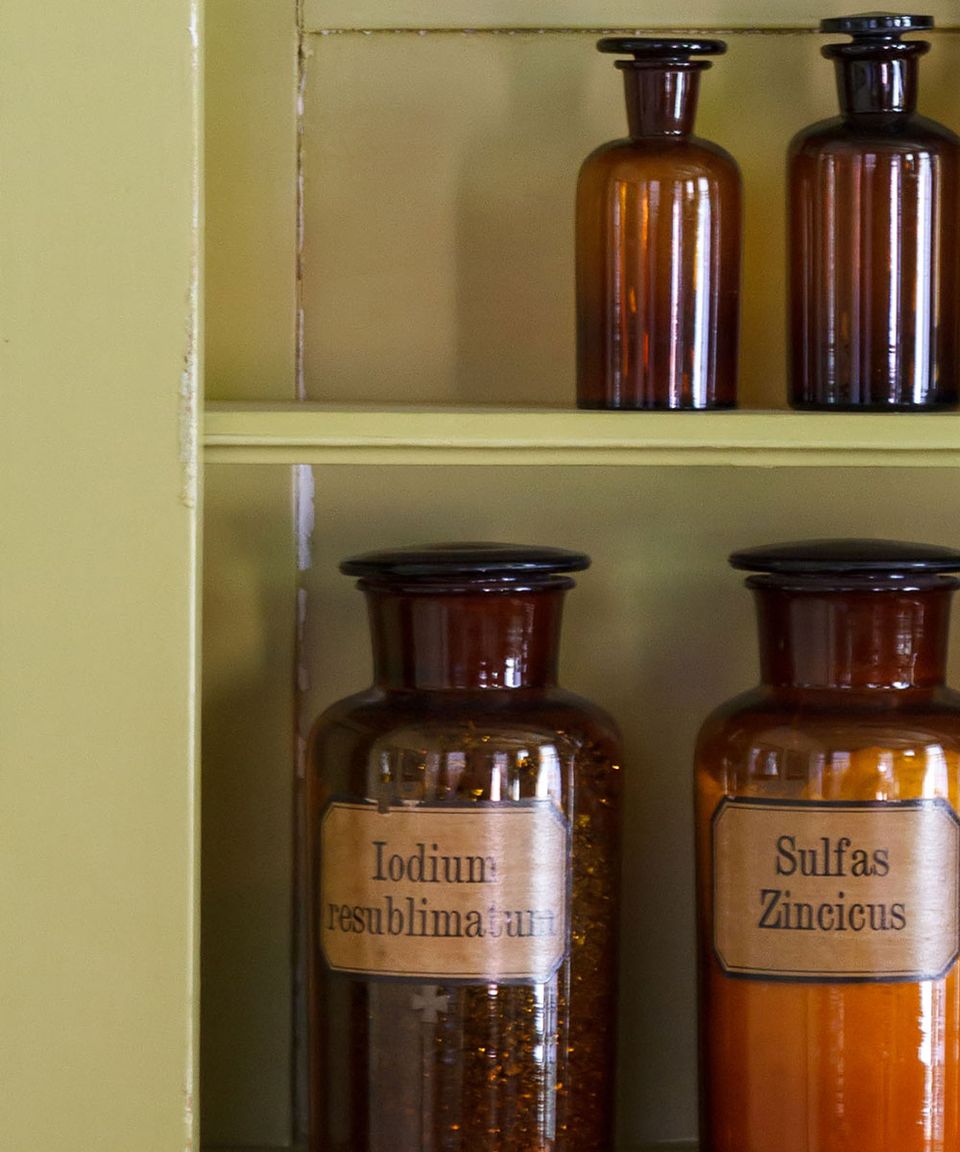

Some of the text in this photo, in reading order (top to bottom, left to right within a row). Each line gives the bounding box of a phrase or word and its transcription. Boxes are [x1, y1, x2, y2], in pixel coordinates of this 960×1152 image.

[371, 840, 496, 884] Iodium
[775, 835, 891, 878] Sulfas
[327, 896, 557, 938] resublimatum
[757, 888, 907, 932] Zincicus
